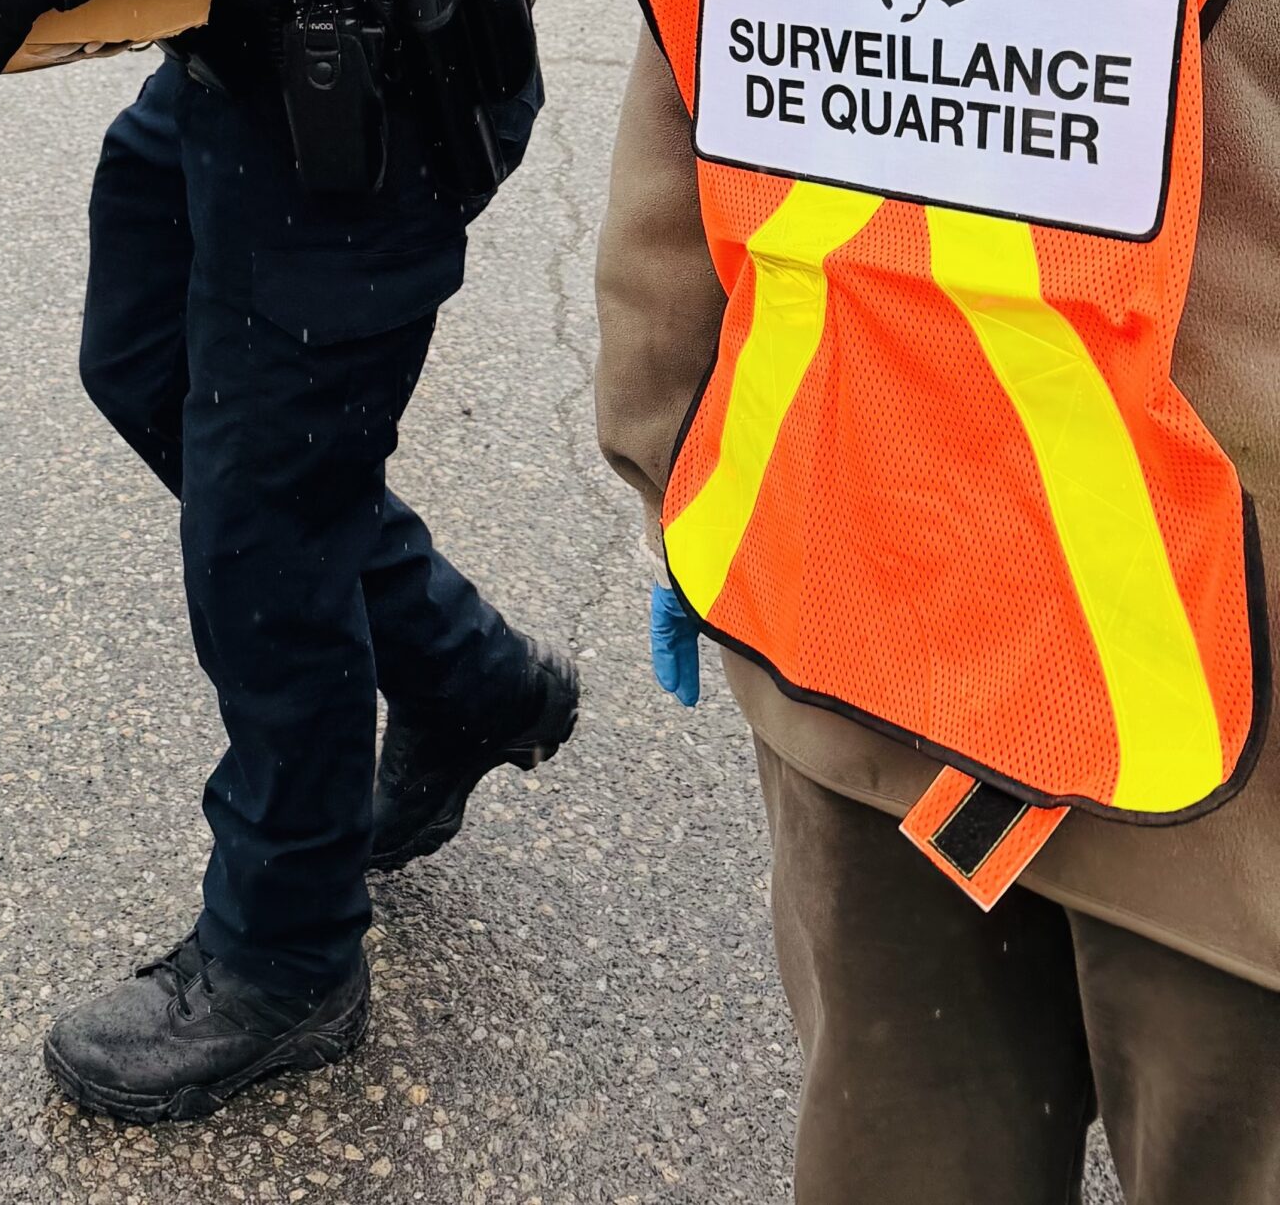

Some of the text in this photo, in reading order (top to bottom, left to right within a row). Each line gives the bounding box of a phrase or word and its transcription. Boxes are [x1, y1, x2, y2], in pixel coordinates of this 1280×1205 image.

[728, 18, 1132, 106] SURVEILLANCE
[746, 74, 1100, 165] DE QUARTIER
